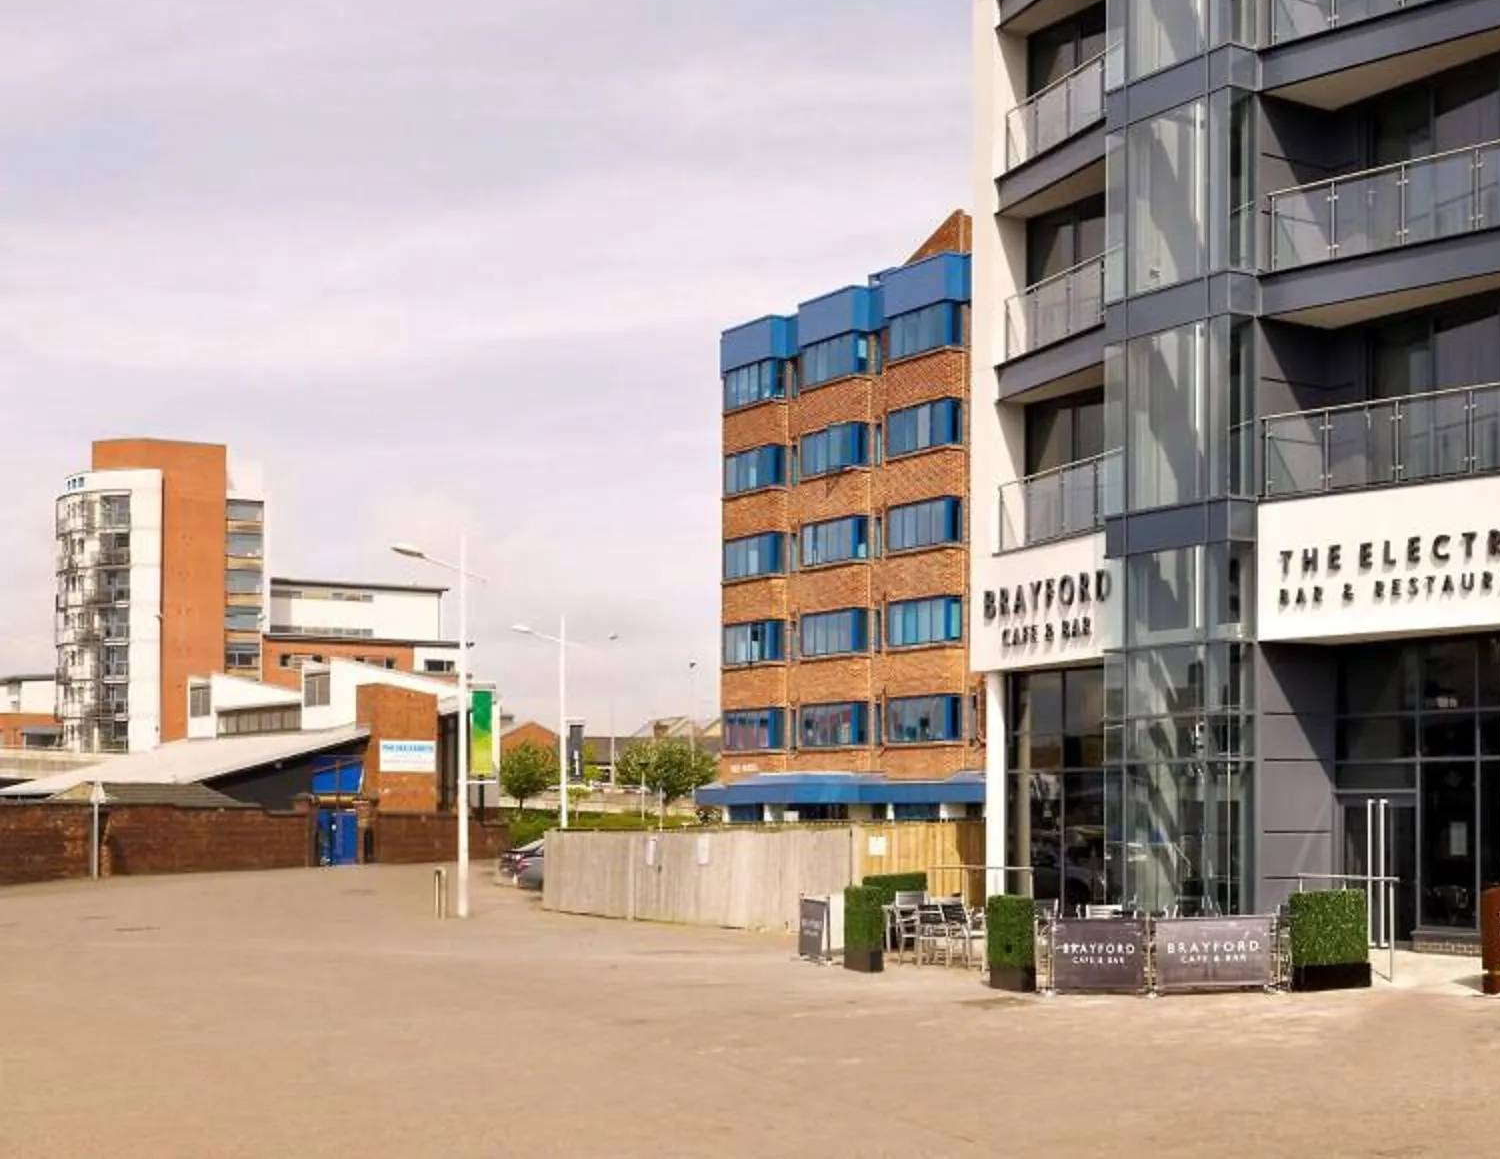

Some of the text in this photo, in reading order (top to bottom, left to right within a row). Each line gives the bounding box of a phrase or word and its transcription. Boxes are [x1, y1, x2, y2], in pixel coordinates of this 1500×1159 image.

[1279, 543, 1342, 575] THE
[983, 569, 1112, 620] BRAYFORD
[1279, 585, 1323, 606] BAR
[1342, 582, 1354, 601] &
[1001, 625, 1038, 647] CAFE
[1061, 616, 1092, 640] BAR
[1063, 942, 1135, 954] BRAYFORD
[1167, 940, 1260, 954] BRAYFORD
